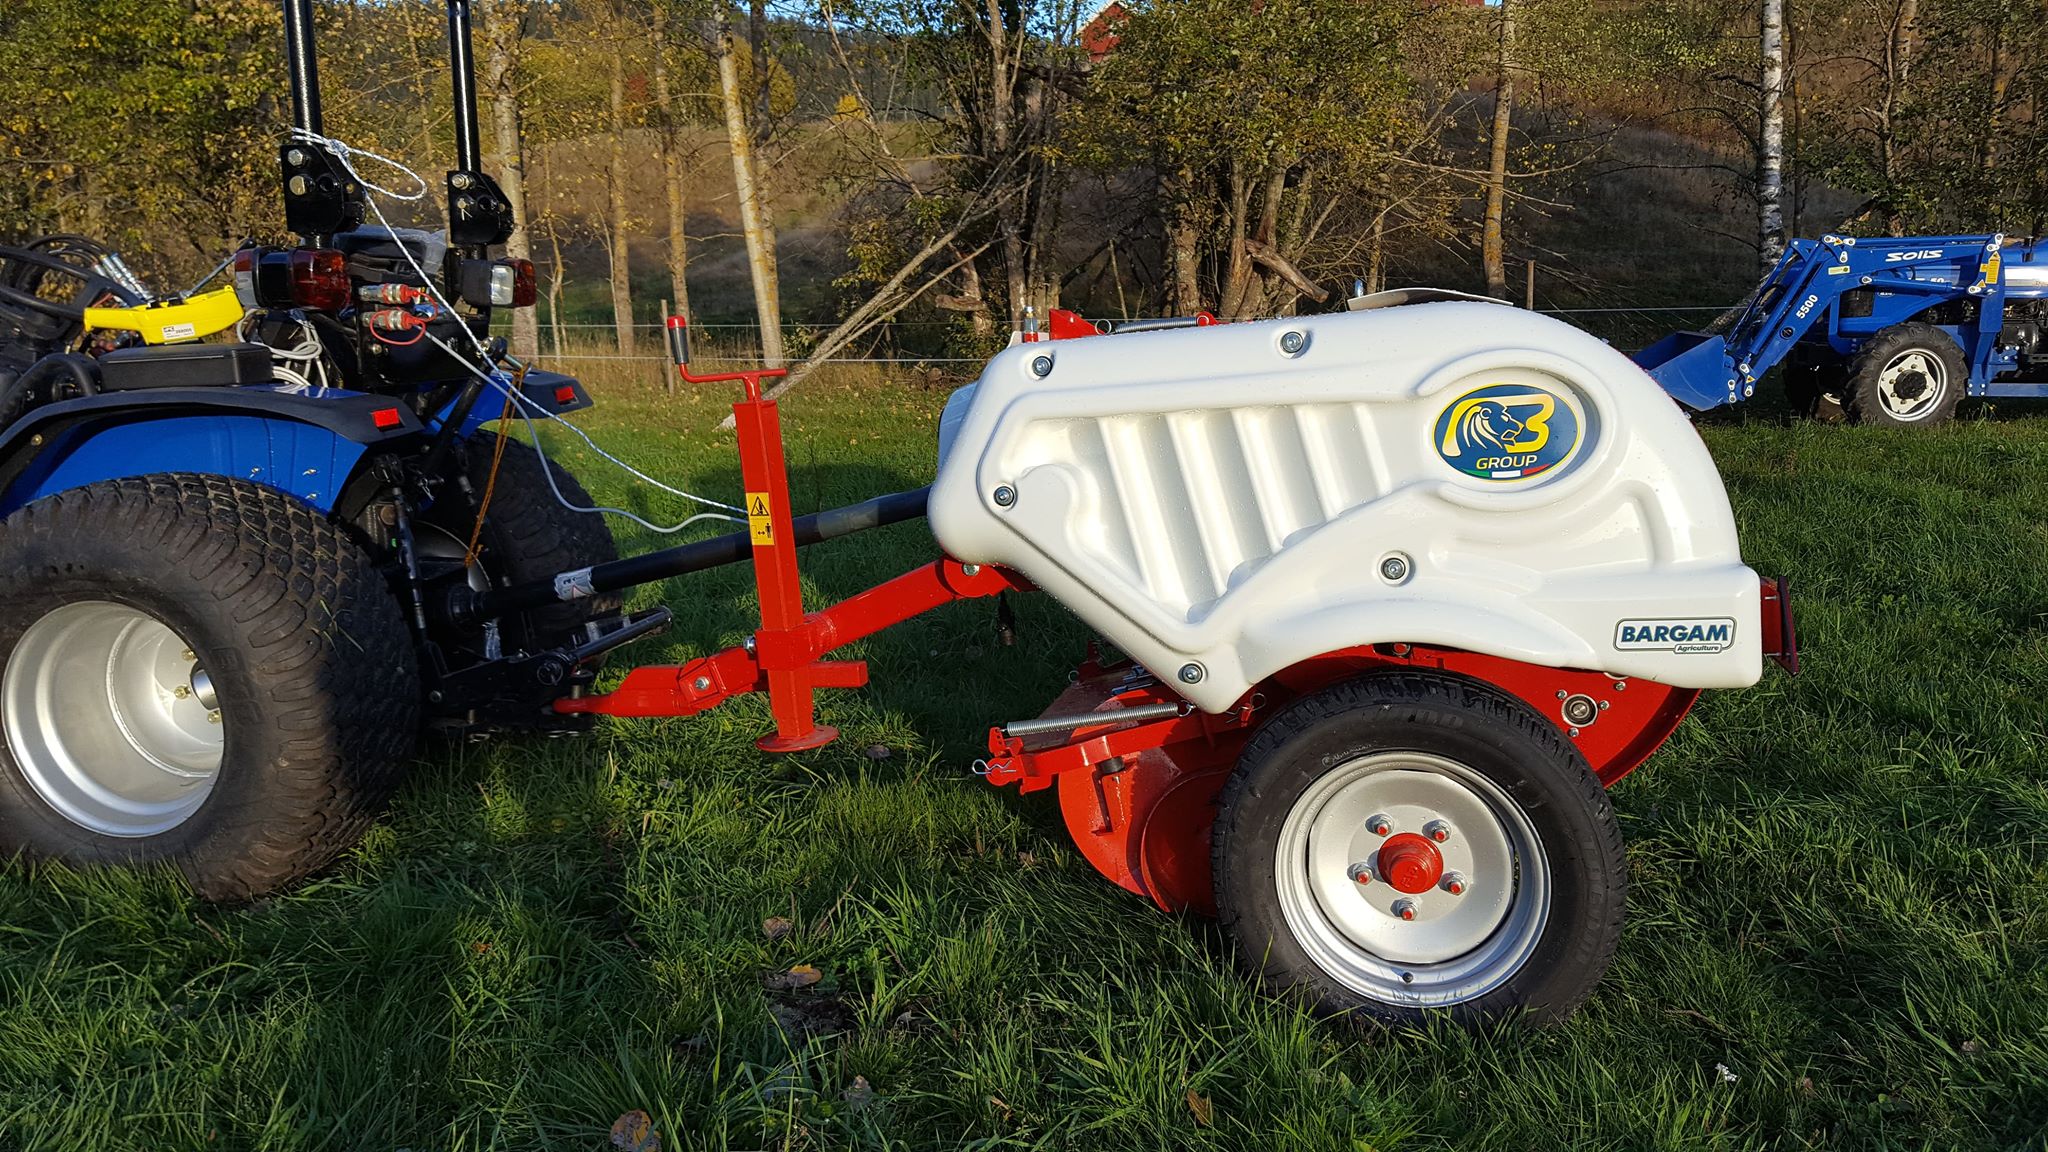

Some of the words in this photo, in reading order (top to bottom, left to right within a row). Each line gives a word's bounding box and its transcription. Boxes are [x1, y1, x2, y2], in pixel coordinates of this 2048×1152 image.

[1885, 250, 1944, 262] SOLIS
[1796, 294, 1819, 319] 5500
[1475, 454, 1538, 470] GROUP
[1620, 624, 1729, 643] BARGAM
[1677, 645, 1720, 653] Agriculture
